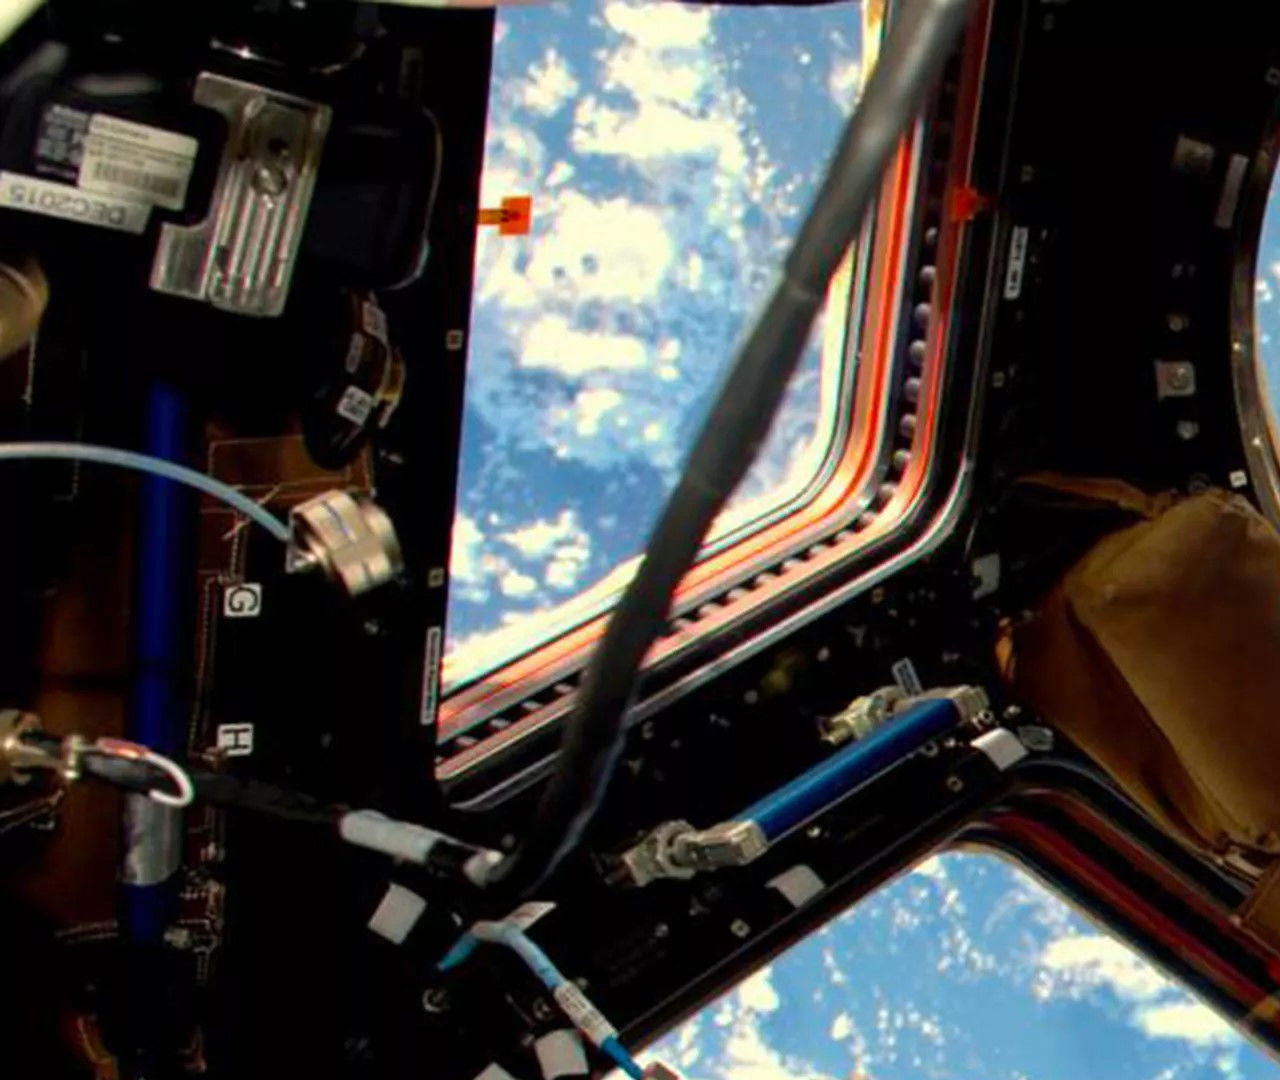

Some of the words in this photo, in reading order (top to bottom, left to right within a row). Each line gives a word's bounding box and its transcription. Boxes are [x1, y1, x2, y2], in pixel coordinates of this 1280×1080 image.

[8, 184, 127, 227] DEC2015
[228, 586, 258, 613] G
[221, 727, 251, 750] H
